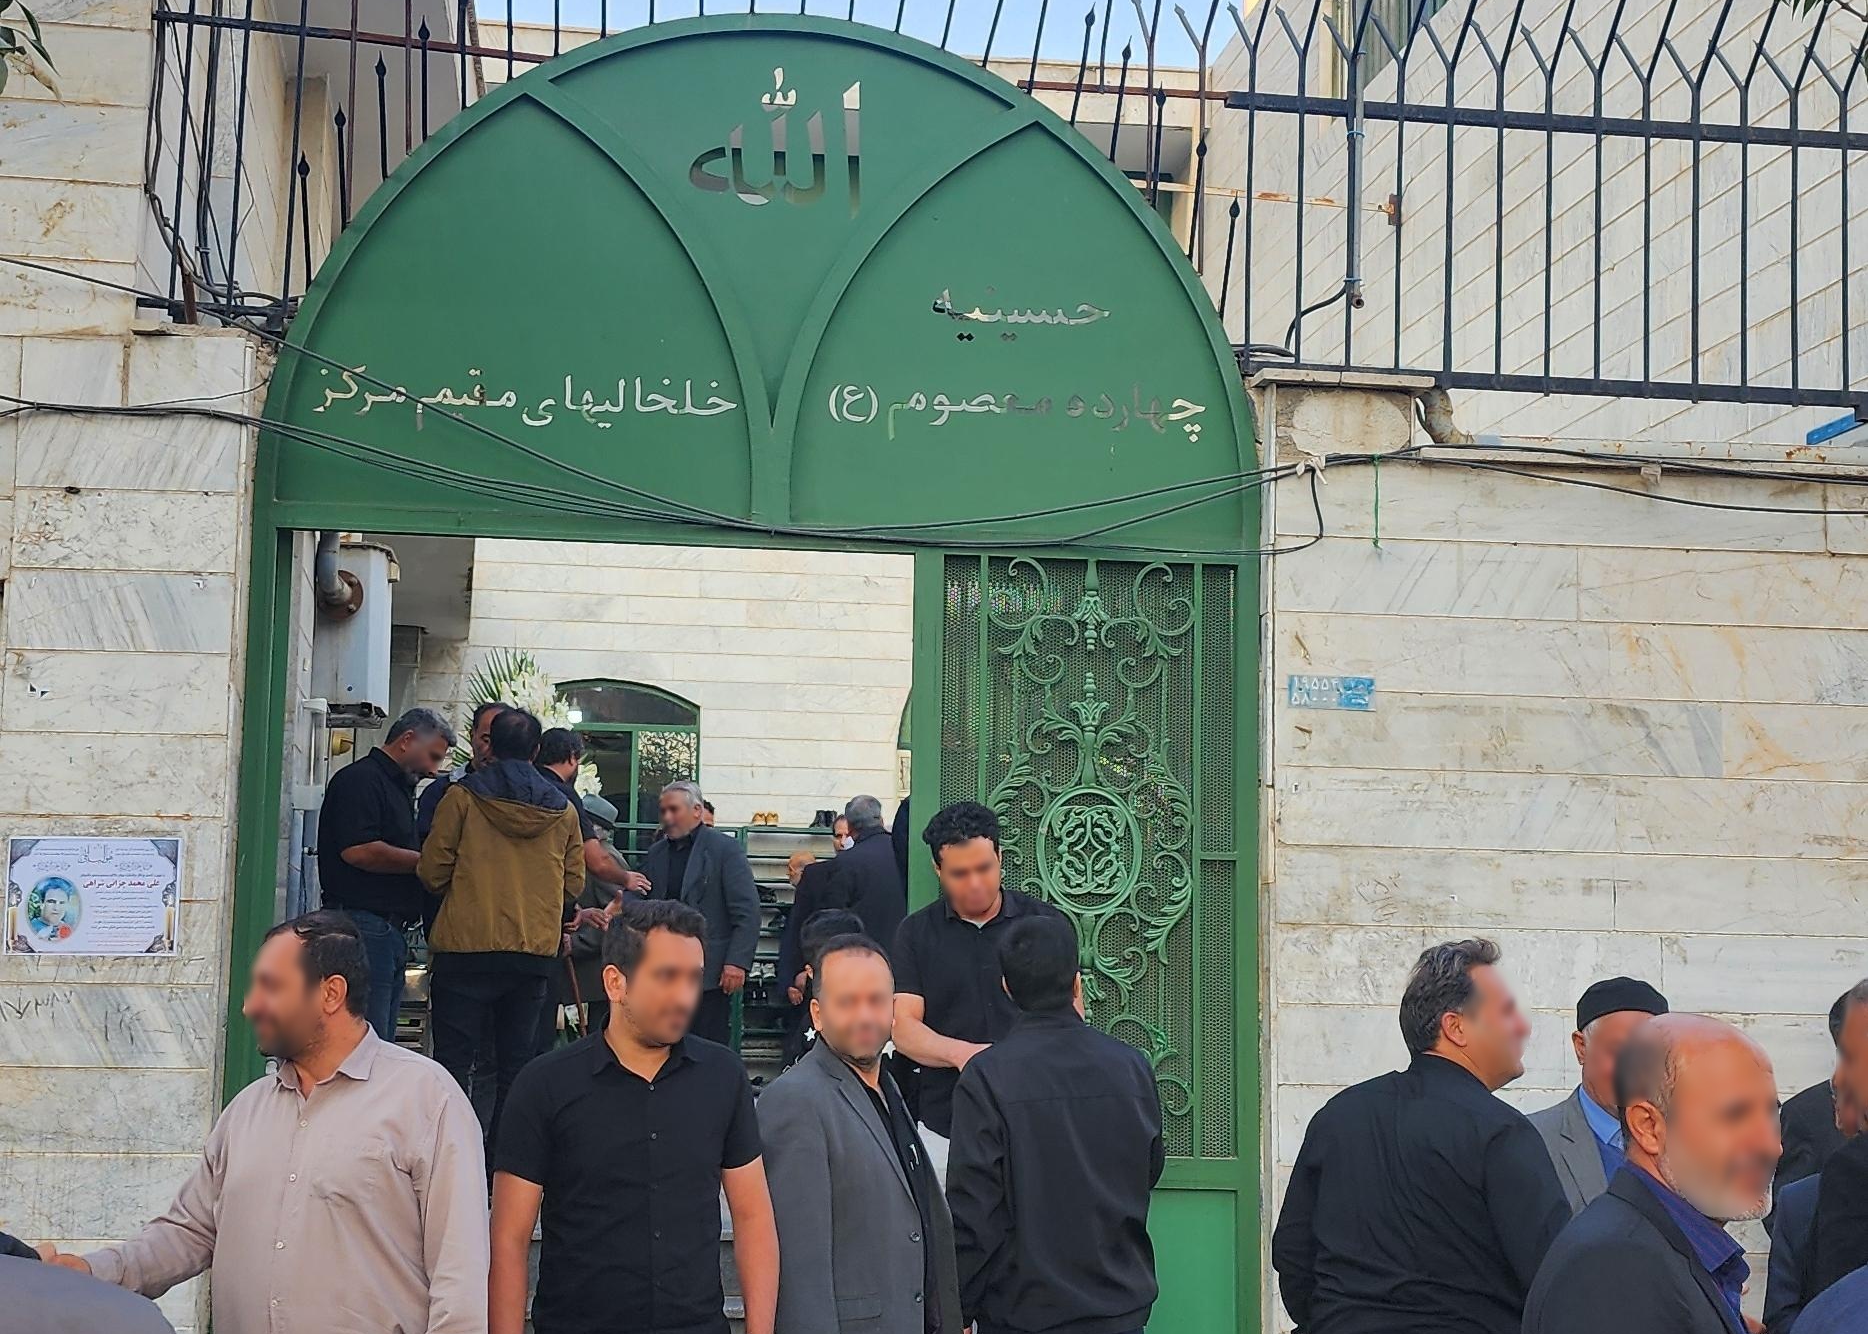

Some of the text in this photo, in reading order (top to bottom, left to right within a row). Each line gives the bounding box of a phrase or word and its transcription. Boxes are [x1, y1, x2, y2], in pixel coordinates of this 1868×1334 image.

[932, 285, 1111, 343] حسینیه
[312, 365, 407, 415] مرکز
[416, 368, 517, 432] مقیم
[887, 391, 1052, 441] معصوم
[1065, 381, 1206, 443] چهارده
